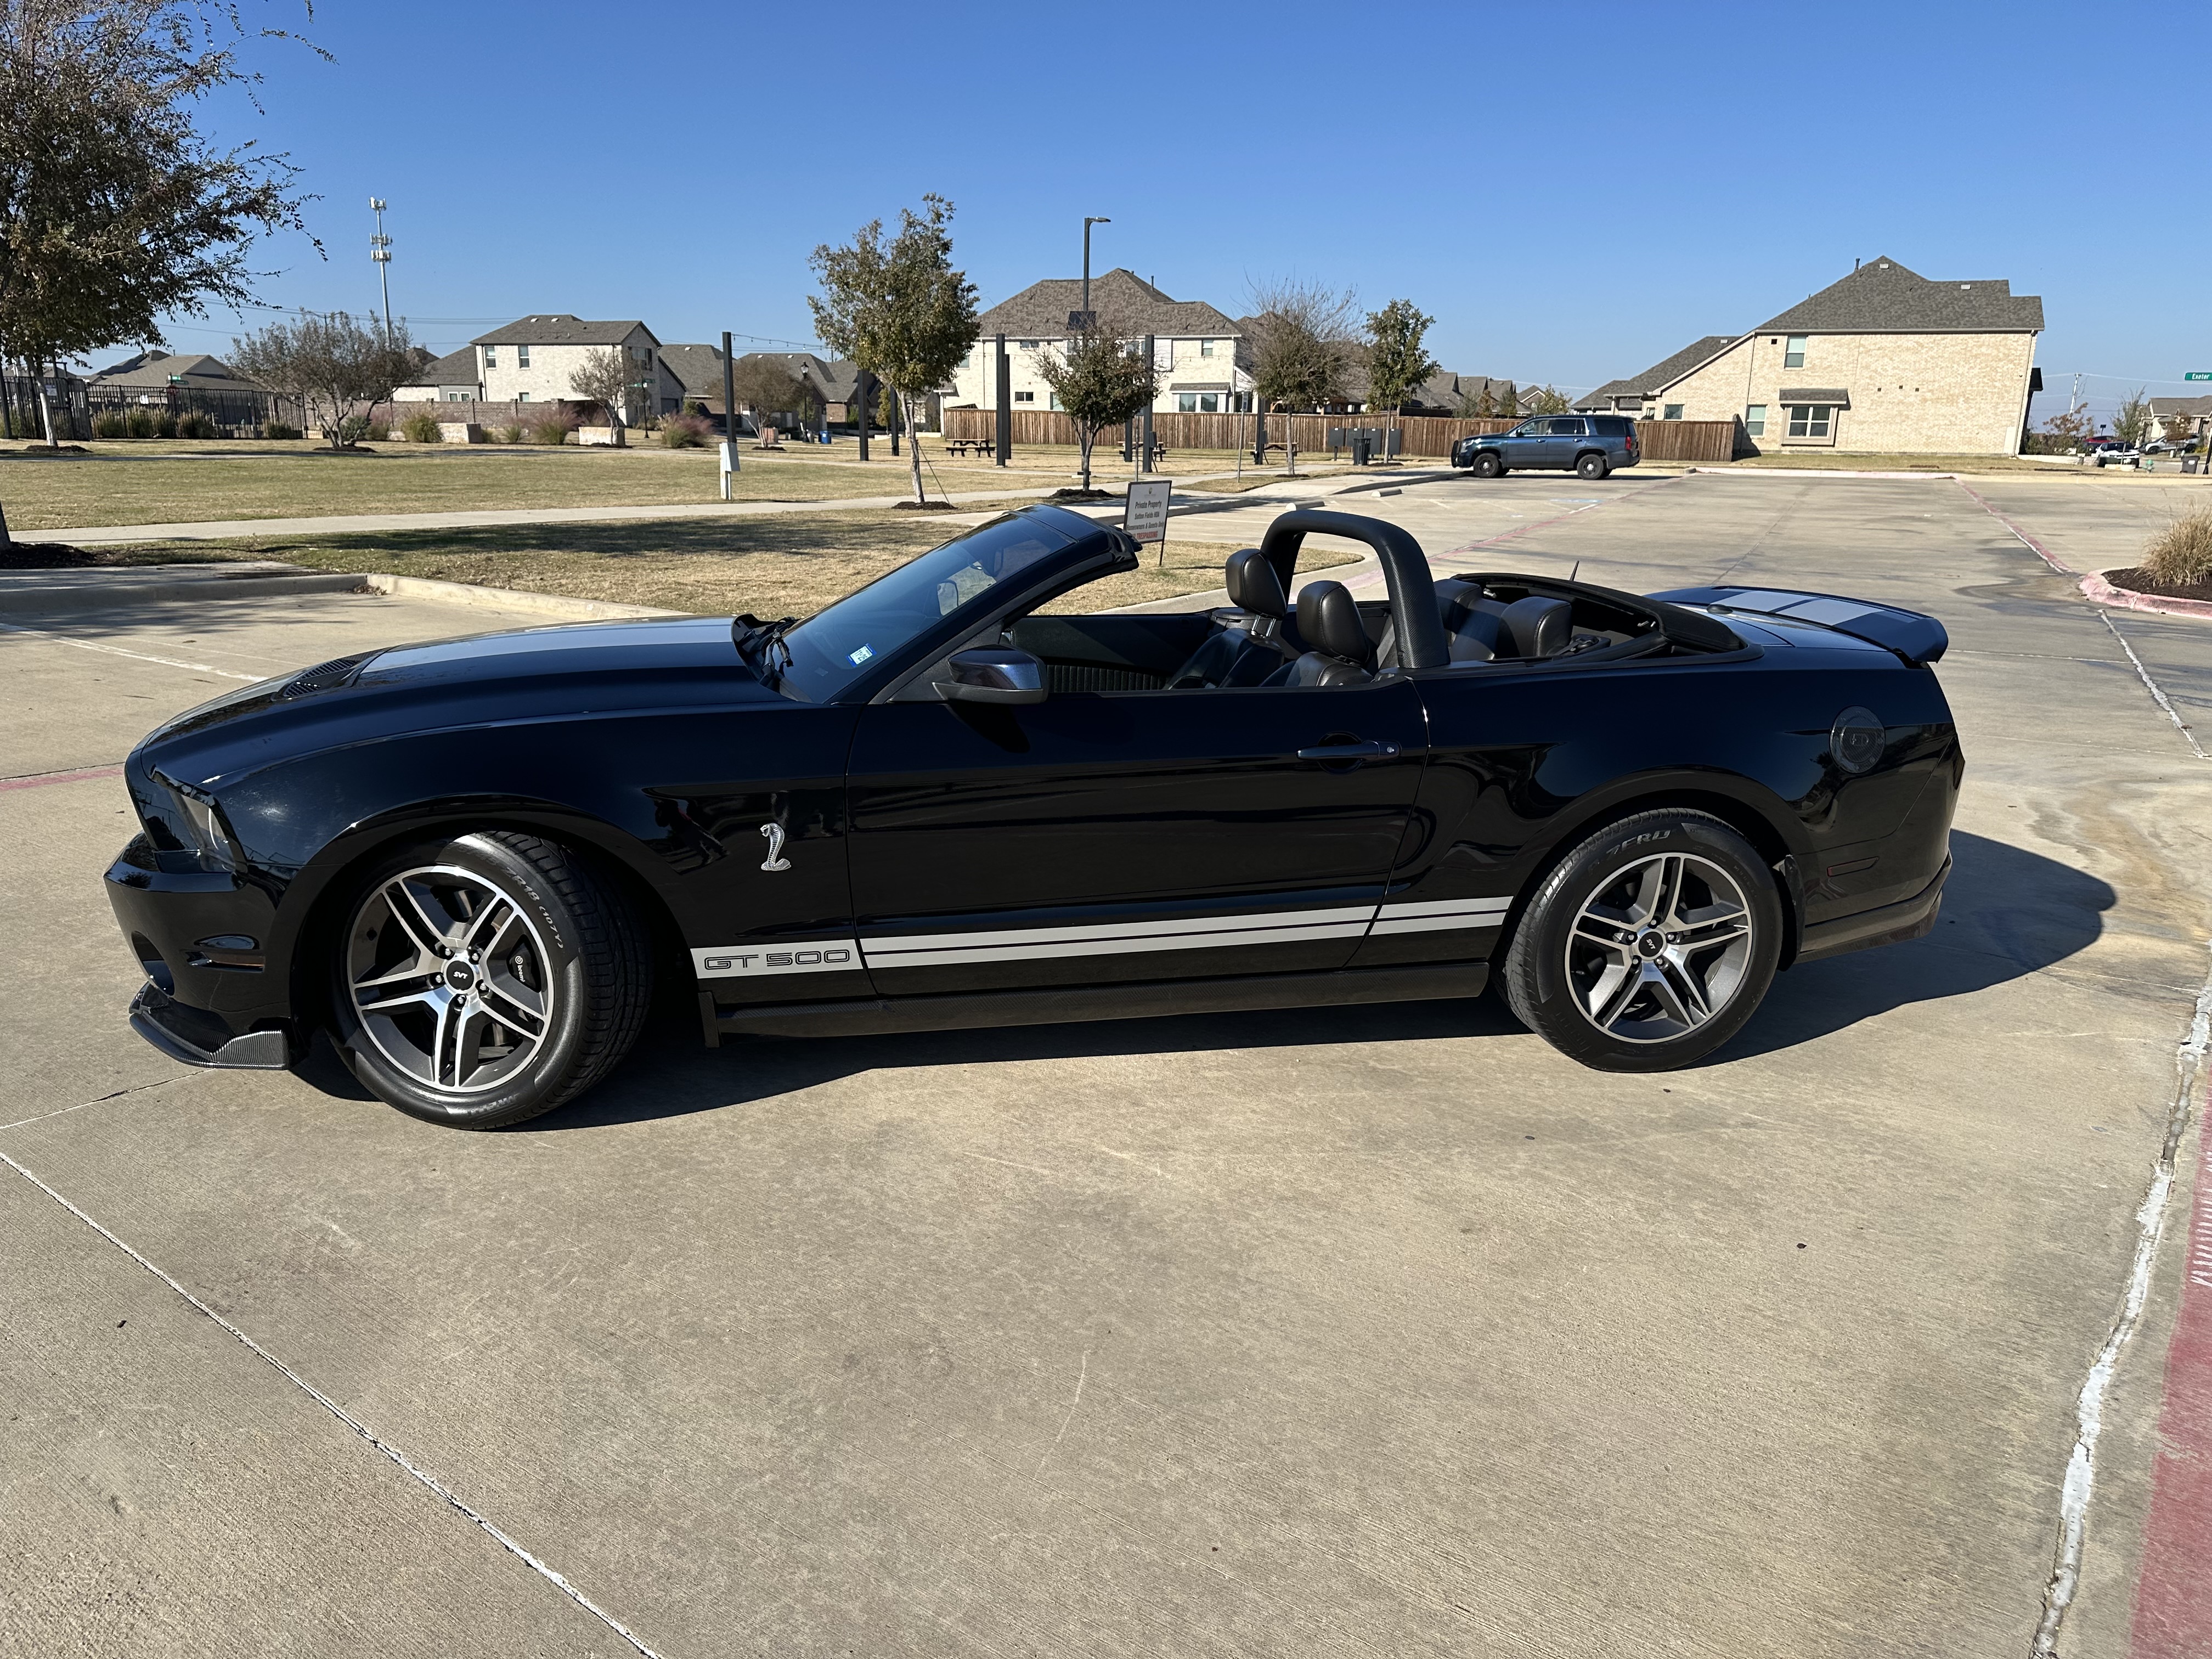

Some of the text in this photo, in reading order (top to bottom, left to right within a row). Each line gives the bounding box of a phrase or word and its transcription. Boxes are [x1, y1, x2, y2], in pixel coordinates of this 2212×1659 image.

[1148, 500, 1162, 509] Property
[1646, 938, 1656, 949] SVT
[704, 949, 850, 970] GT 500
[453, 971, 468, 979] SVT
